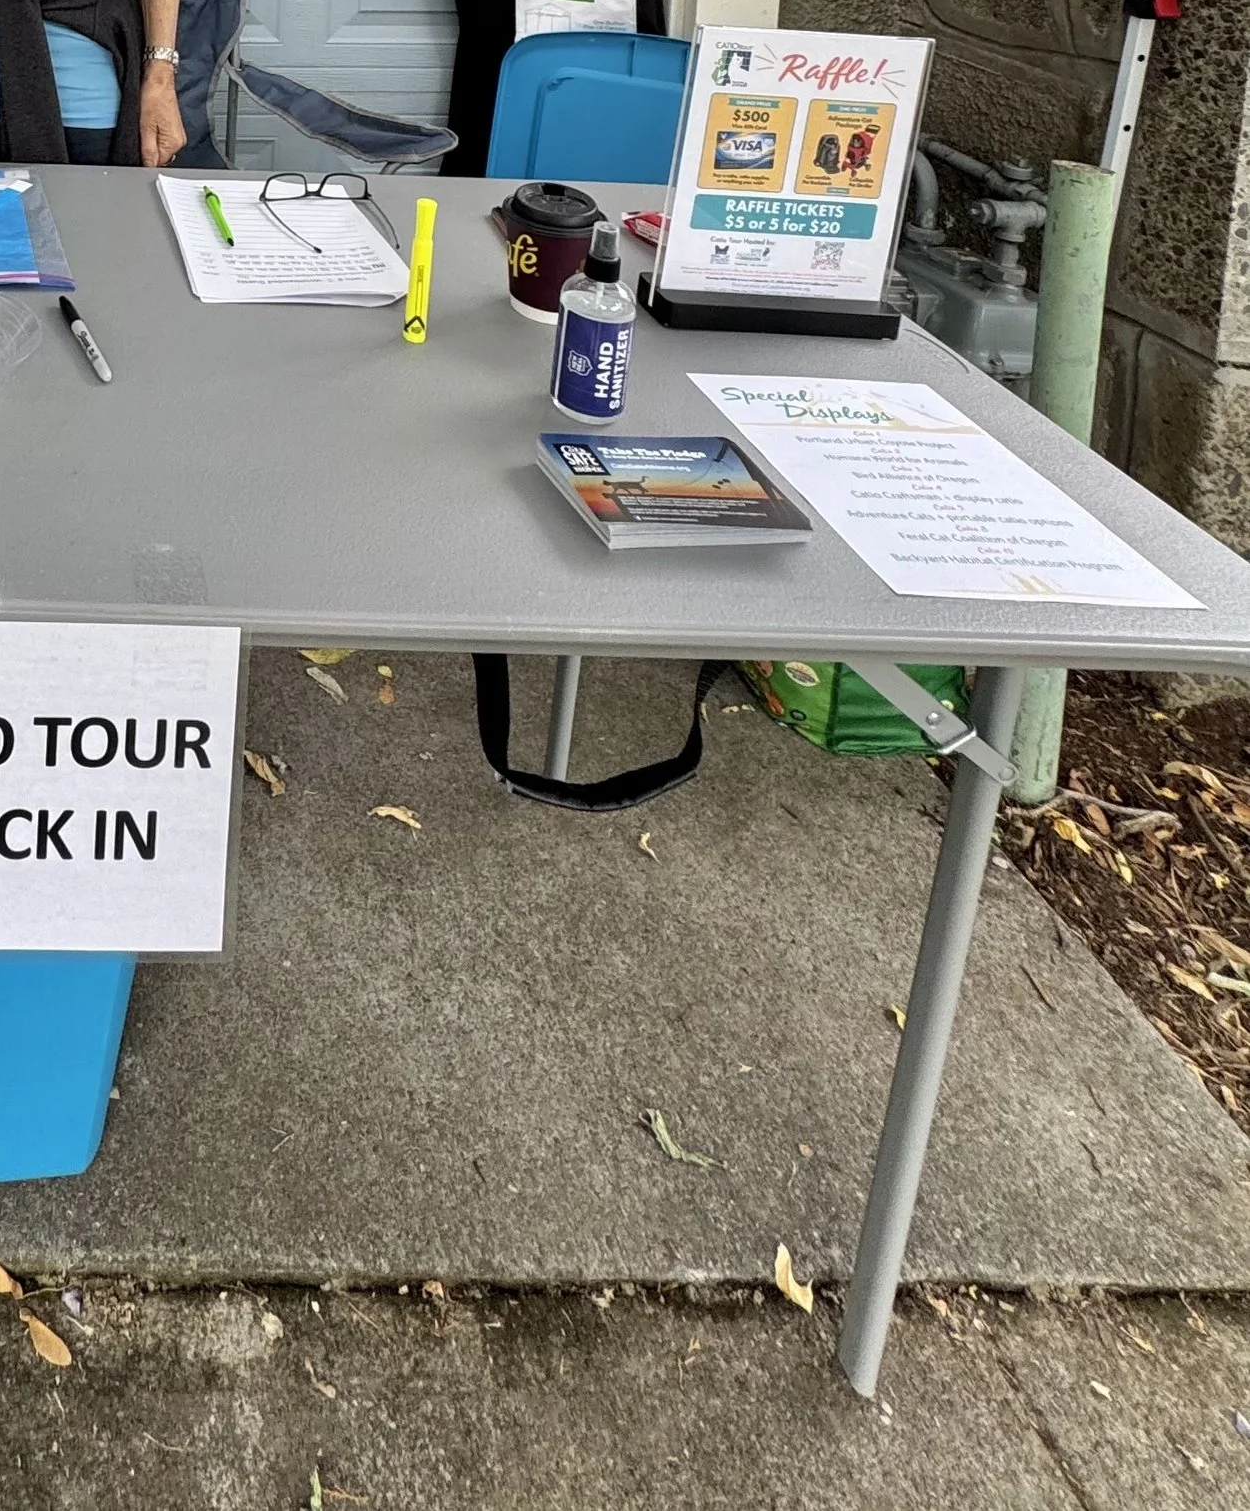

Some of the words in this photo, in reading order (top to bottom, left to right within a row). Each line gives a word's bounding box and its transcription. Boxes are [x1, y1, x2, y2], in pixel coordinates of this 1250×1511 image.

[778, 53, 887, 90] Raffle!
[733, 109, 770, 122] $500
[733, 140, 762, 151] VISA
[726, 199, 781, 214] RAFFLE
[784, 202, 844, 218] TICKETS
[725, 214, 744, 229] $5
[749, 221, 766, 229] or
[769, 218, 779, 230] 5
[782, 218, 806, 232] for
[809, 219, 841, 234] $20
[594, 341, 614, 399] HAND
[610, 329, 629, 410] SANITIZER
[721, 387, 813, 407] Special
[782, 402, 895, 423] Displays
[566, 452, 599, 467] SAFE
[598, 447, 633, 456] Take
[633, 448, 660, 457] The
[662, 449, 707, 459] Pledge
[33, 717, 211, 768] TOUR
[95, 811, 157, 860] IN
